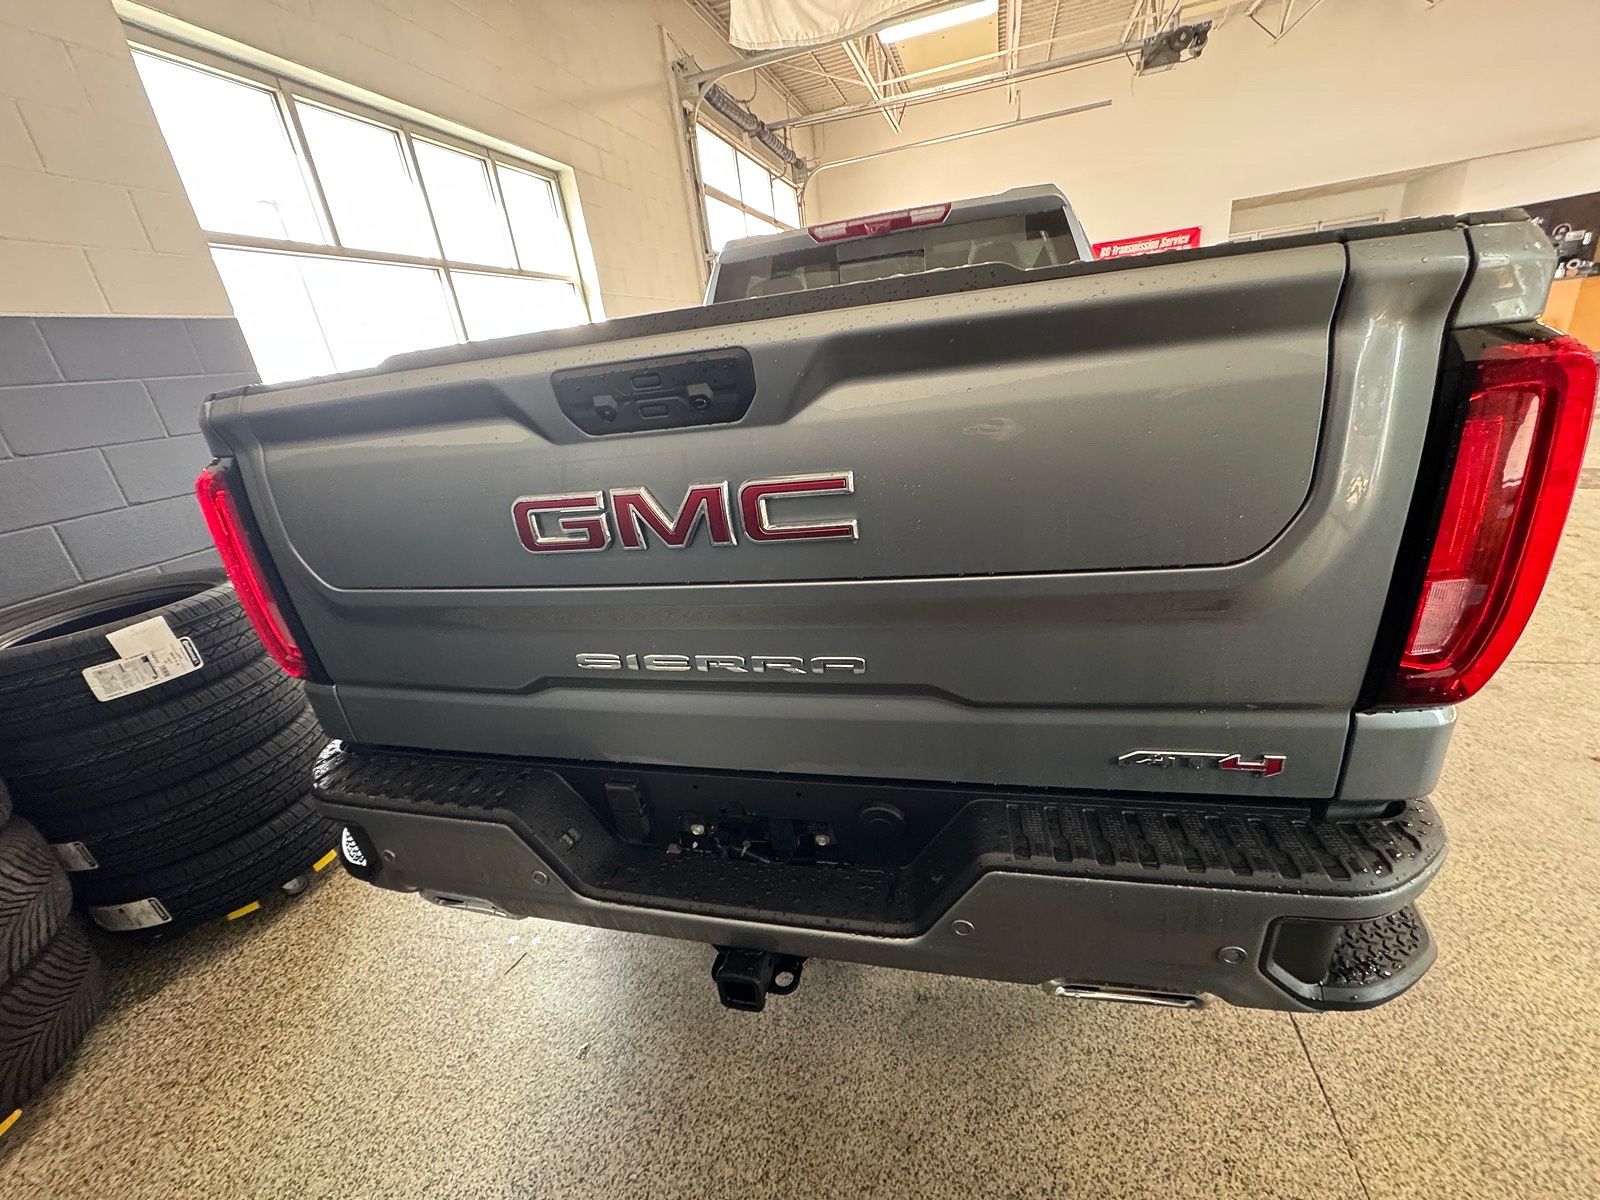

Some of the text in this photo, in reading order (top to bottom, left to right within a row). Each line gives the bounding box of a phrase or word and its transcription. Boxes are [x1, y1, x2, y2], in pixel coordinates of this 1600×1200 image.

[1112, 240, 1160, 255] Transmission
[1160, 234, 1190, 247] Service
[511, 470, 860, 554] GMC
[575, 652, 867, 675] SIERRA
[1117, 750, 1287, 777] AT4
